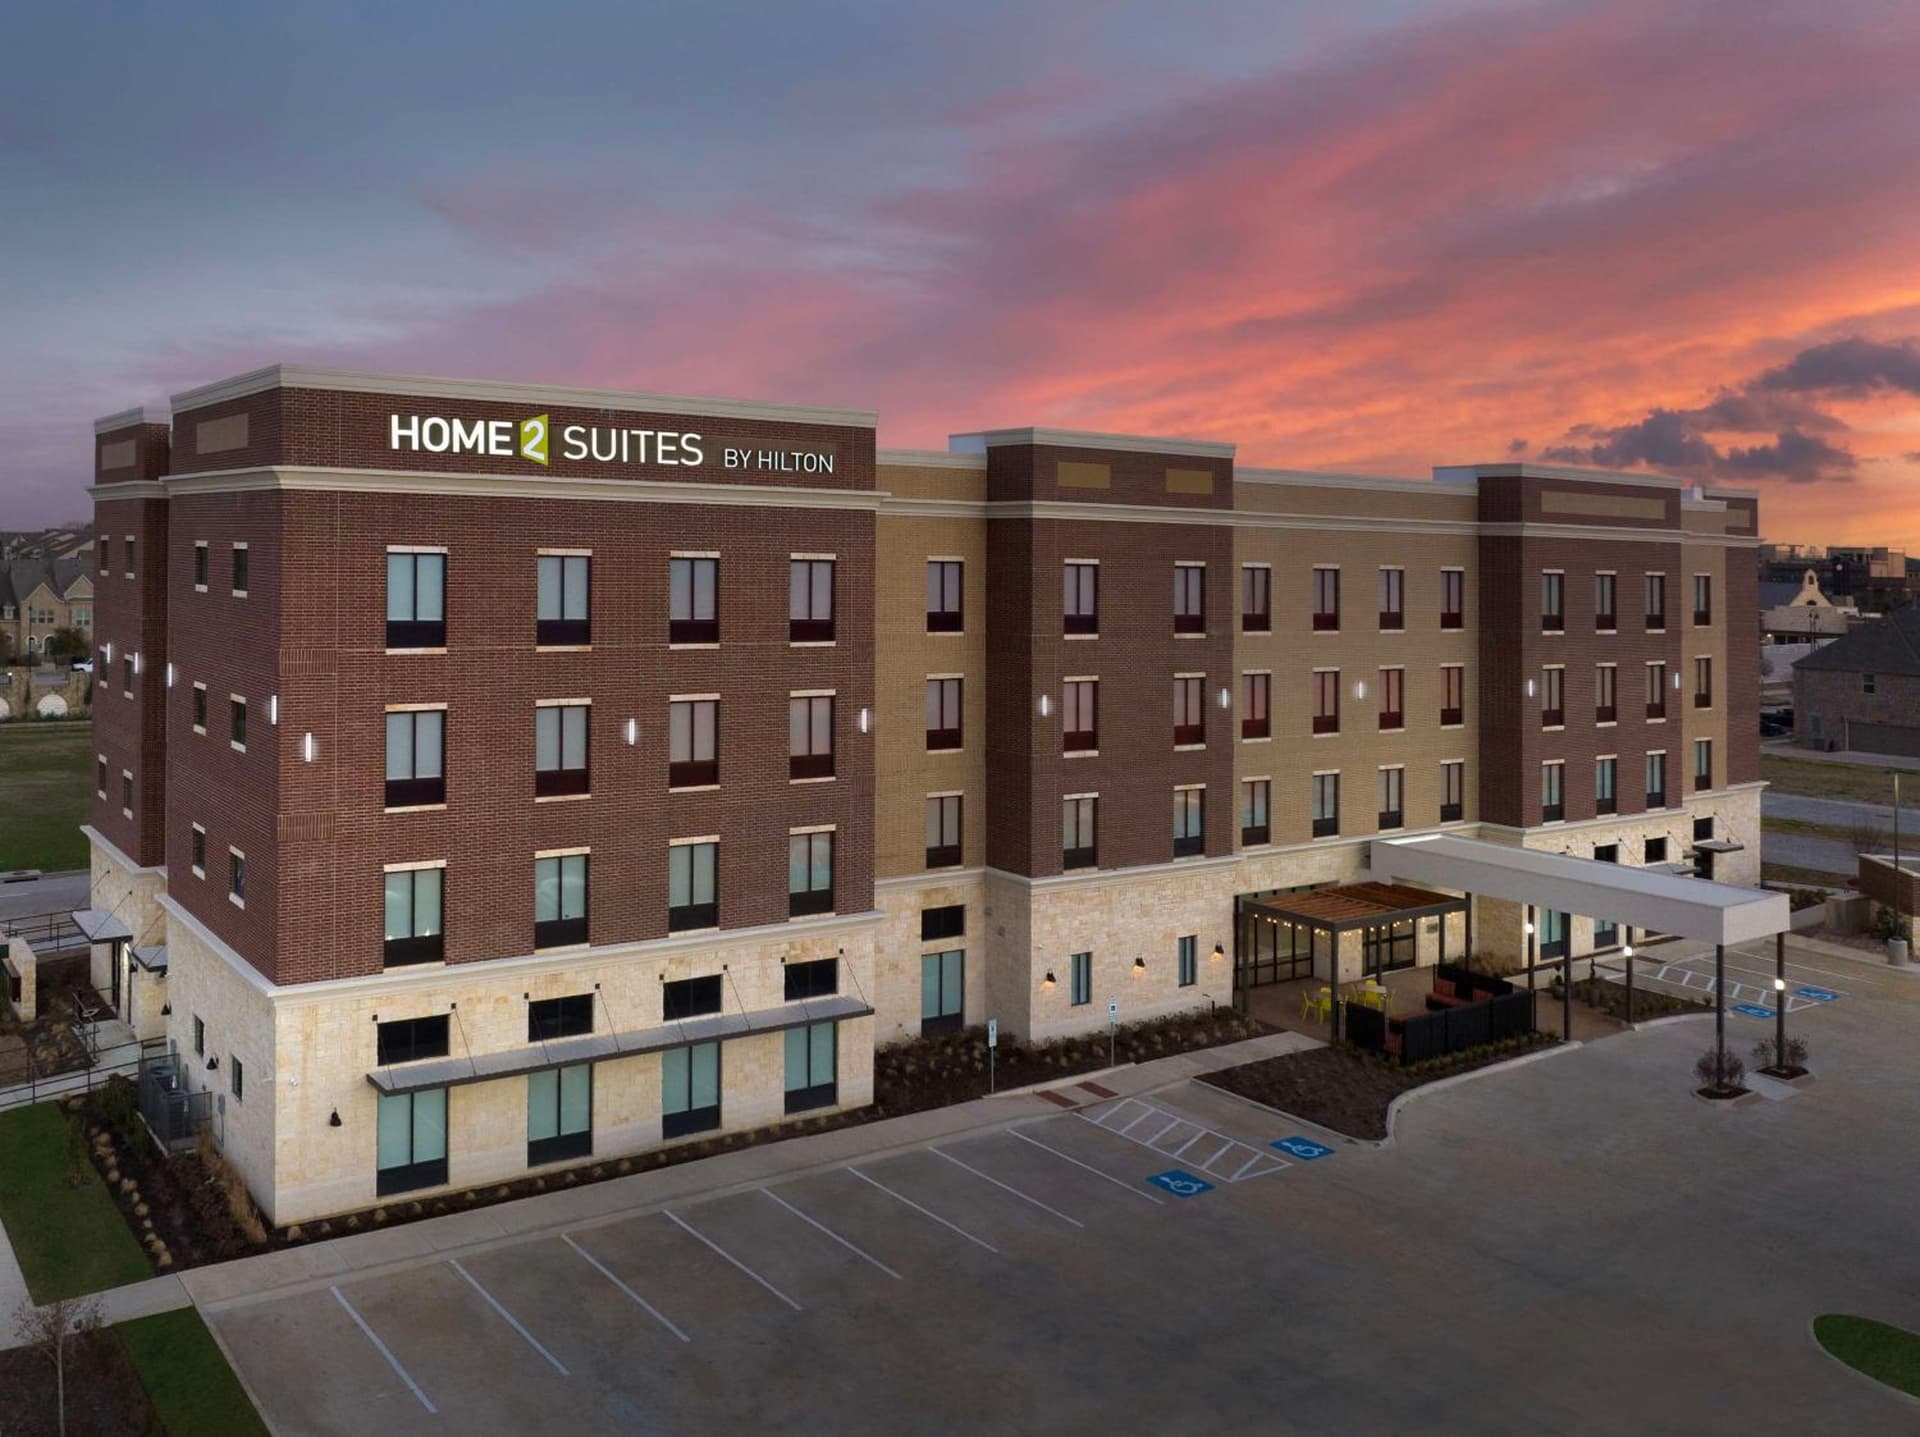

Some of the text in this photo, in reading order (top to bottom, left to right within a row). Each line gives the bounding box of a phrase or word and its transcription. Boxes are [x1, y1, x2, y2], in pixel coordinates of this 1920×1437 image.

[389, 414, 834, 474] HOME 2 SUITES BY HILTON
